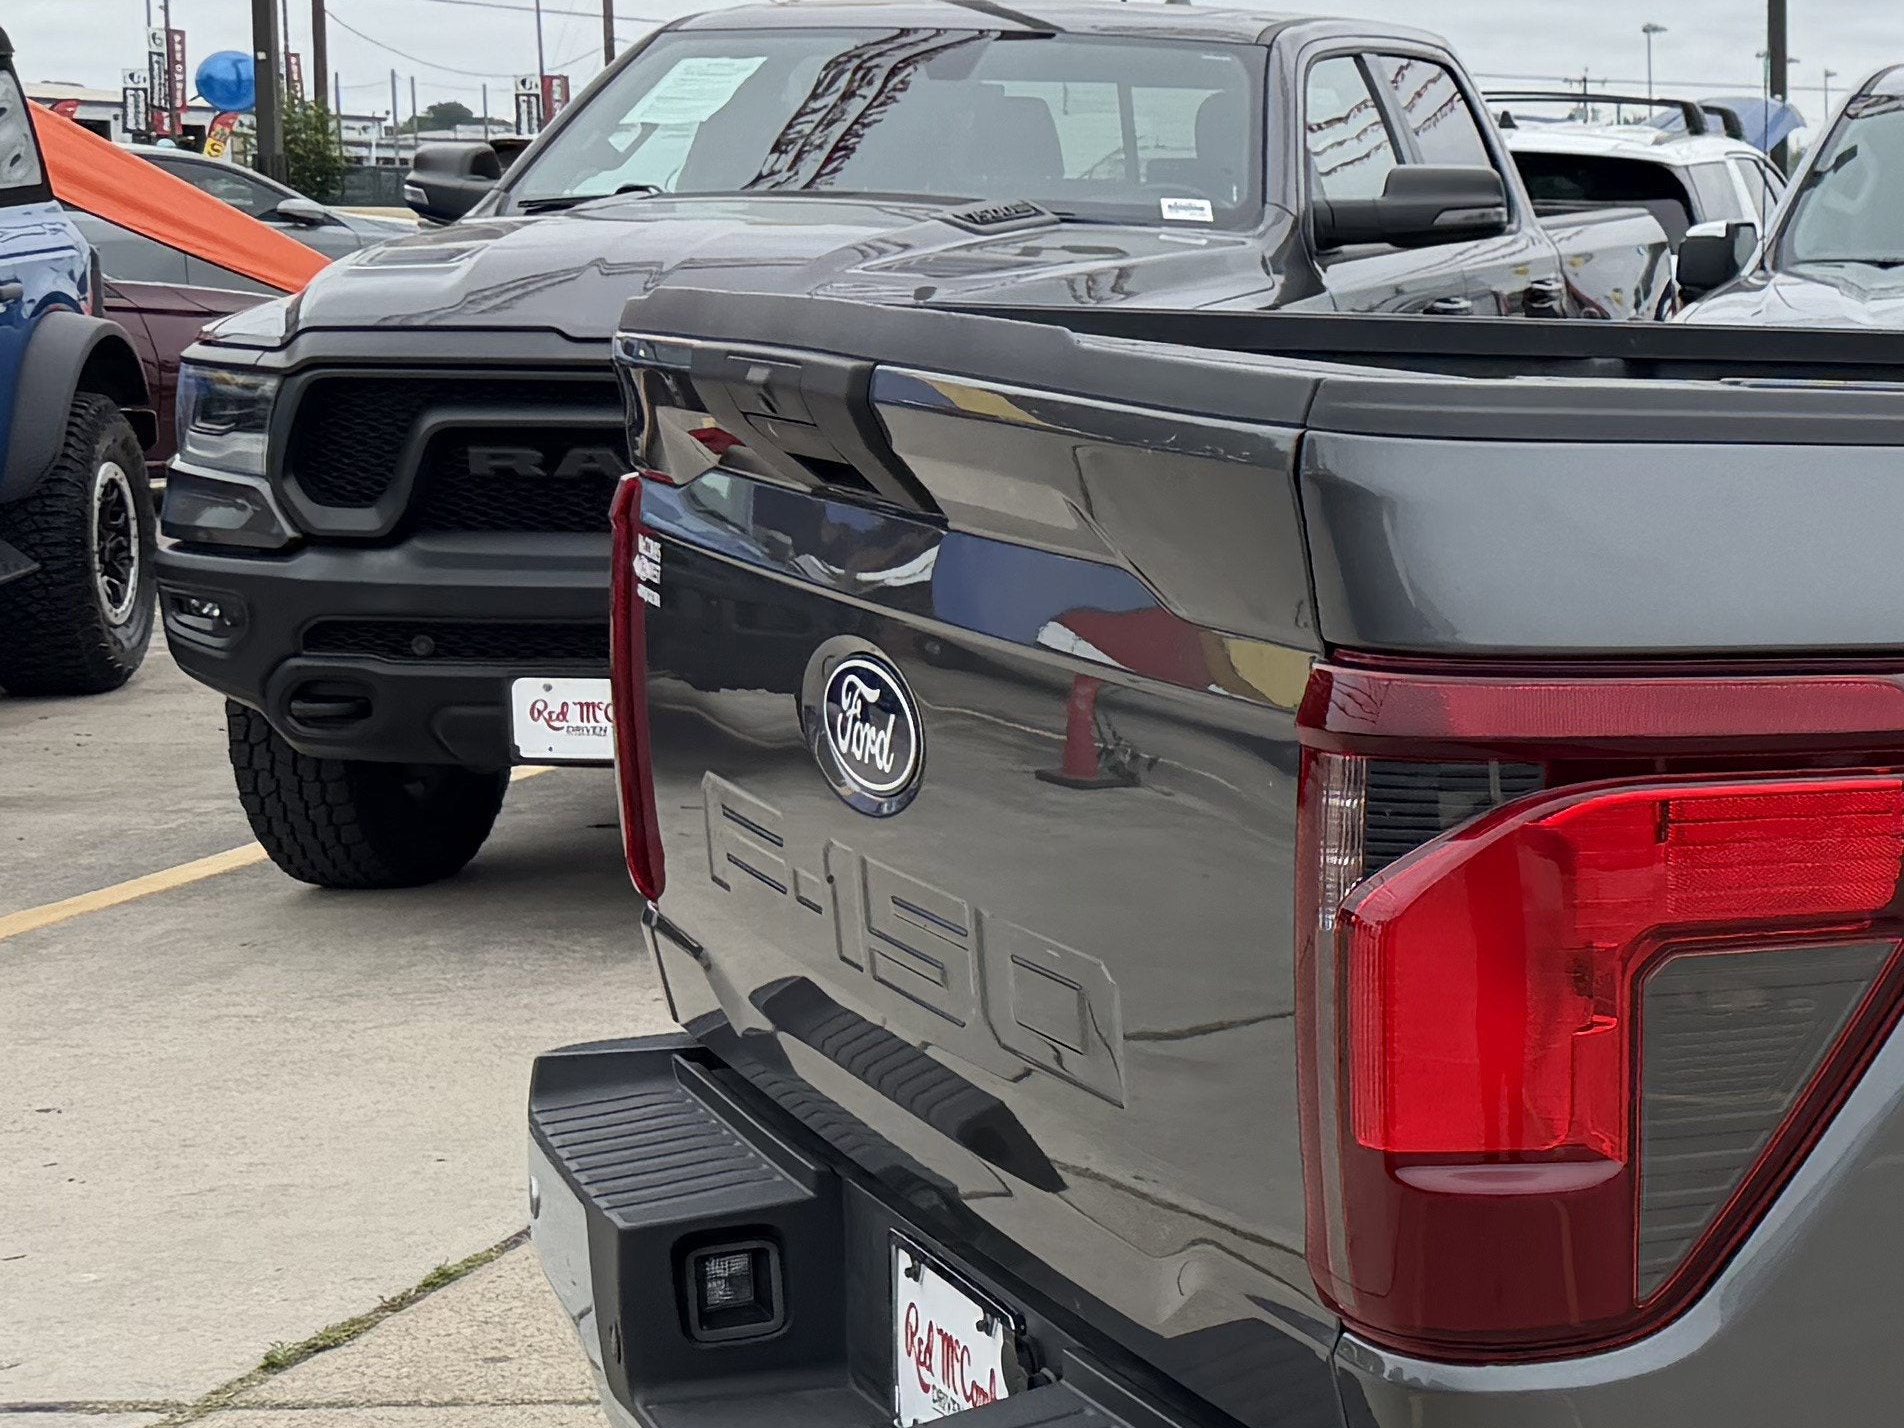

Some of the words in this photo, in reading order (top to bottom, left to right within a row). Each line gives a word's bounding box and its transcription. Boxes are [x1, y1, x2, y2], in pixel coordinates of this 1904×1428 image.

[529, 698, 570, 732] Red
[836, 674, 896, 773] Ford
[703, 770, 1126, 1109] F-150
[905, 1302, 935, 1394] Red
